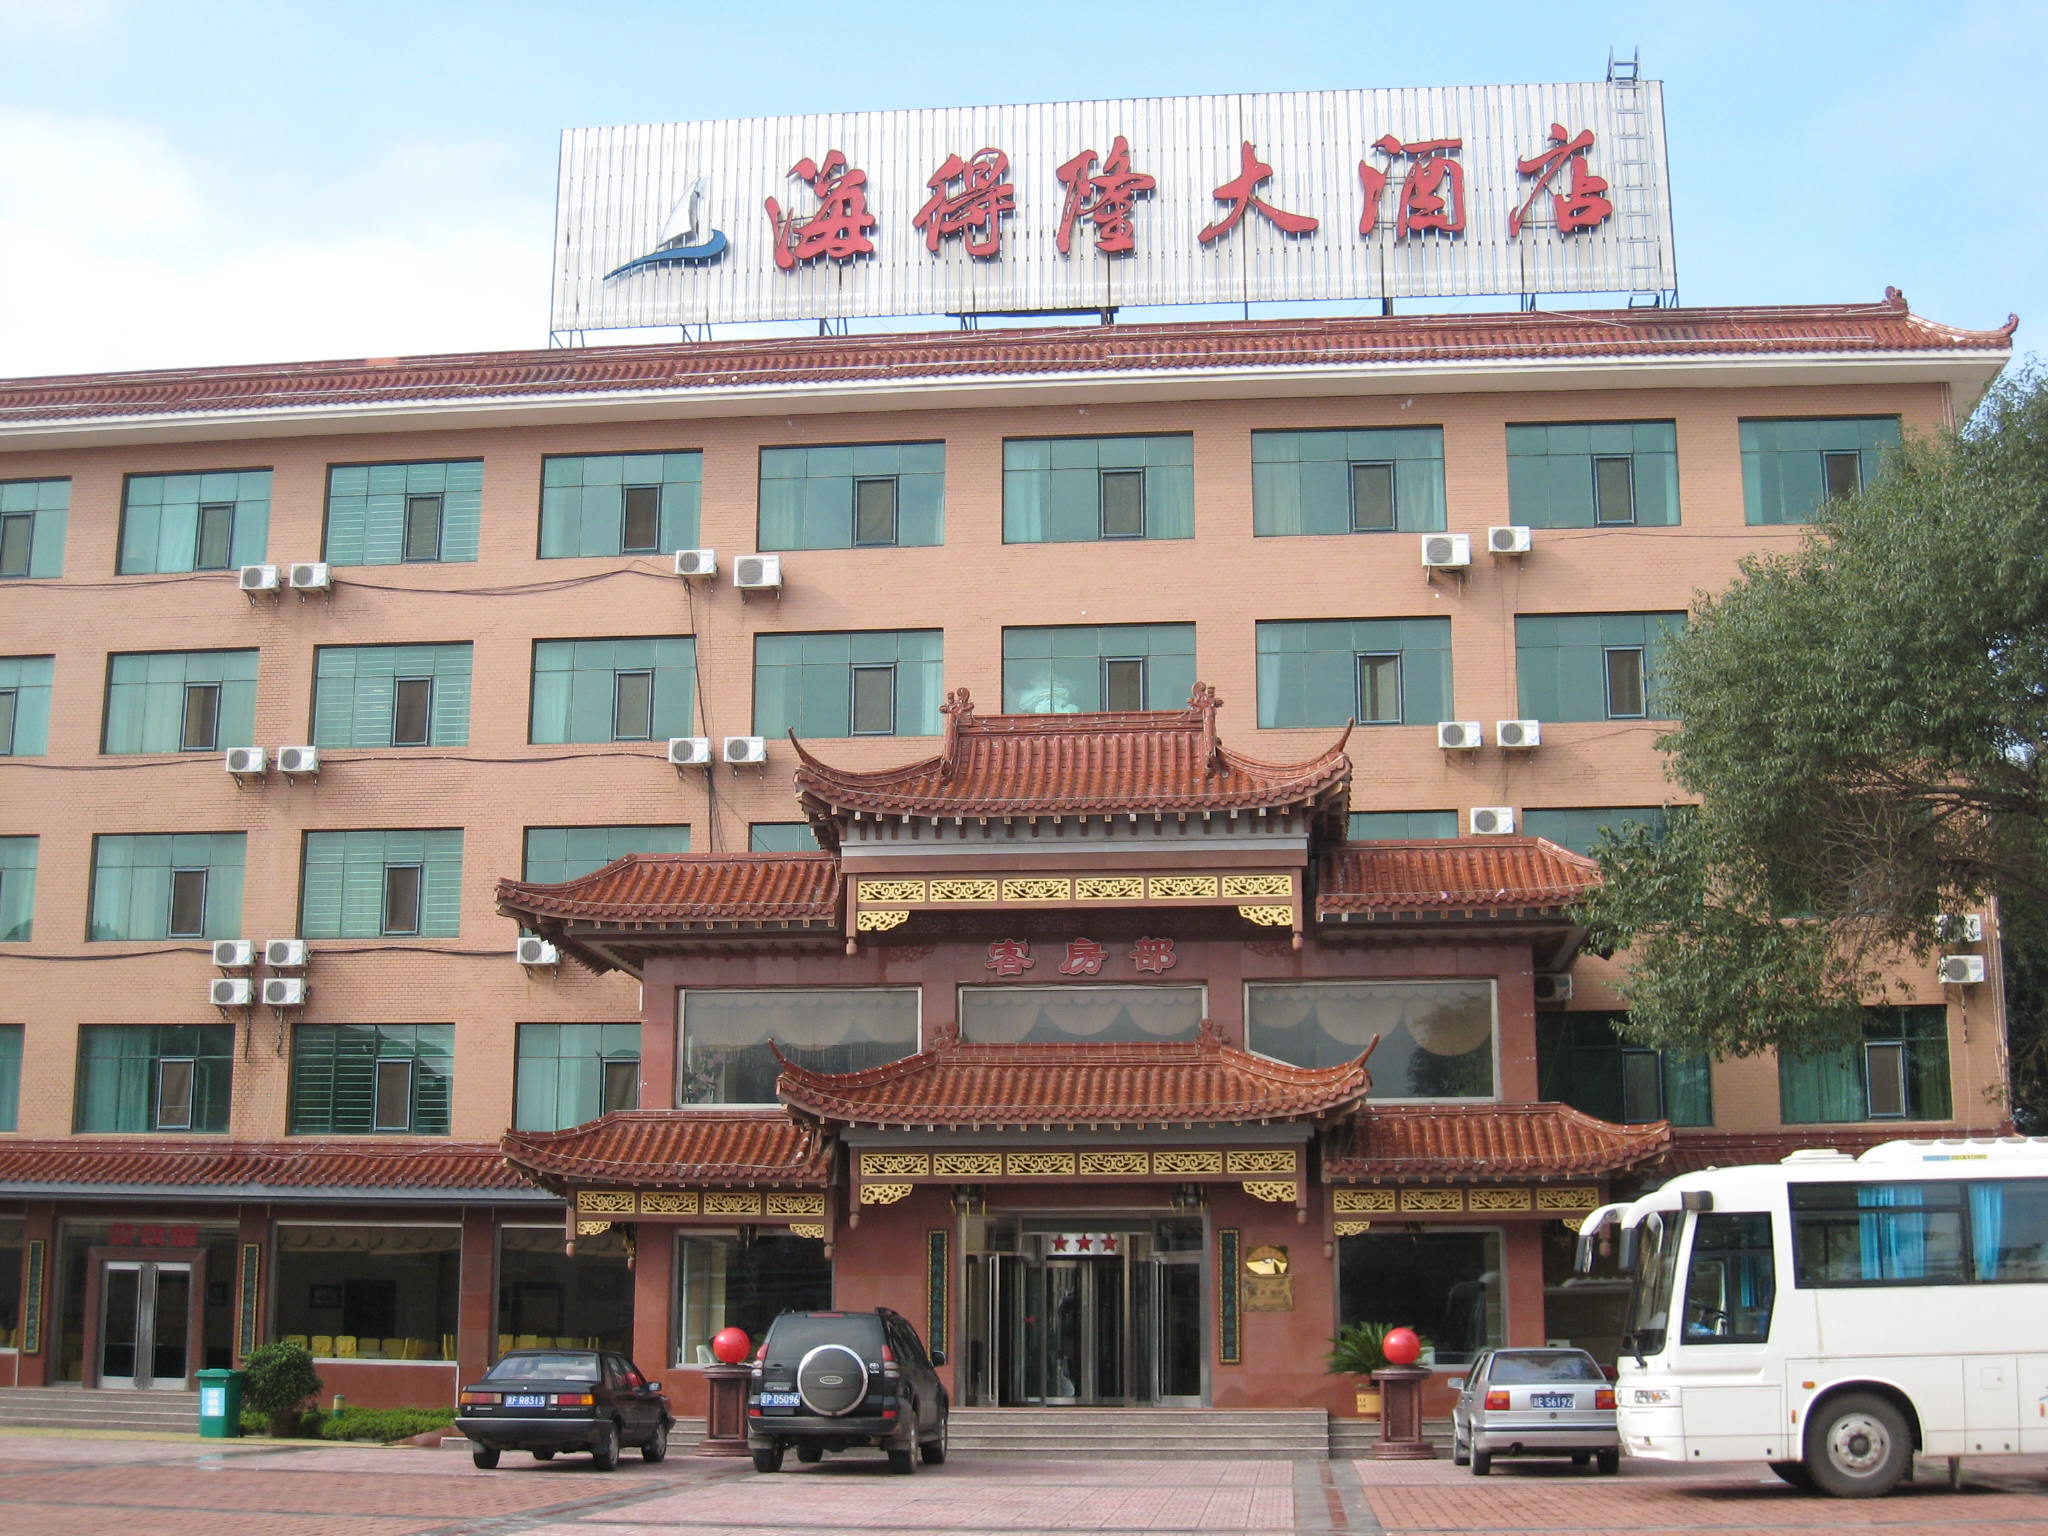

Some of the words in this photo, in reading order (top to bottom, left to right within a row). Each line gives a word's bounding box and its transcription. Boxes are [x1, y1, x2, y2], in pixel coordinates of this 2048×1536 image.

[764, 123, 1613, 270] 海得隆大酒店
[984, 935, 1178, 976] 客房部
